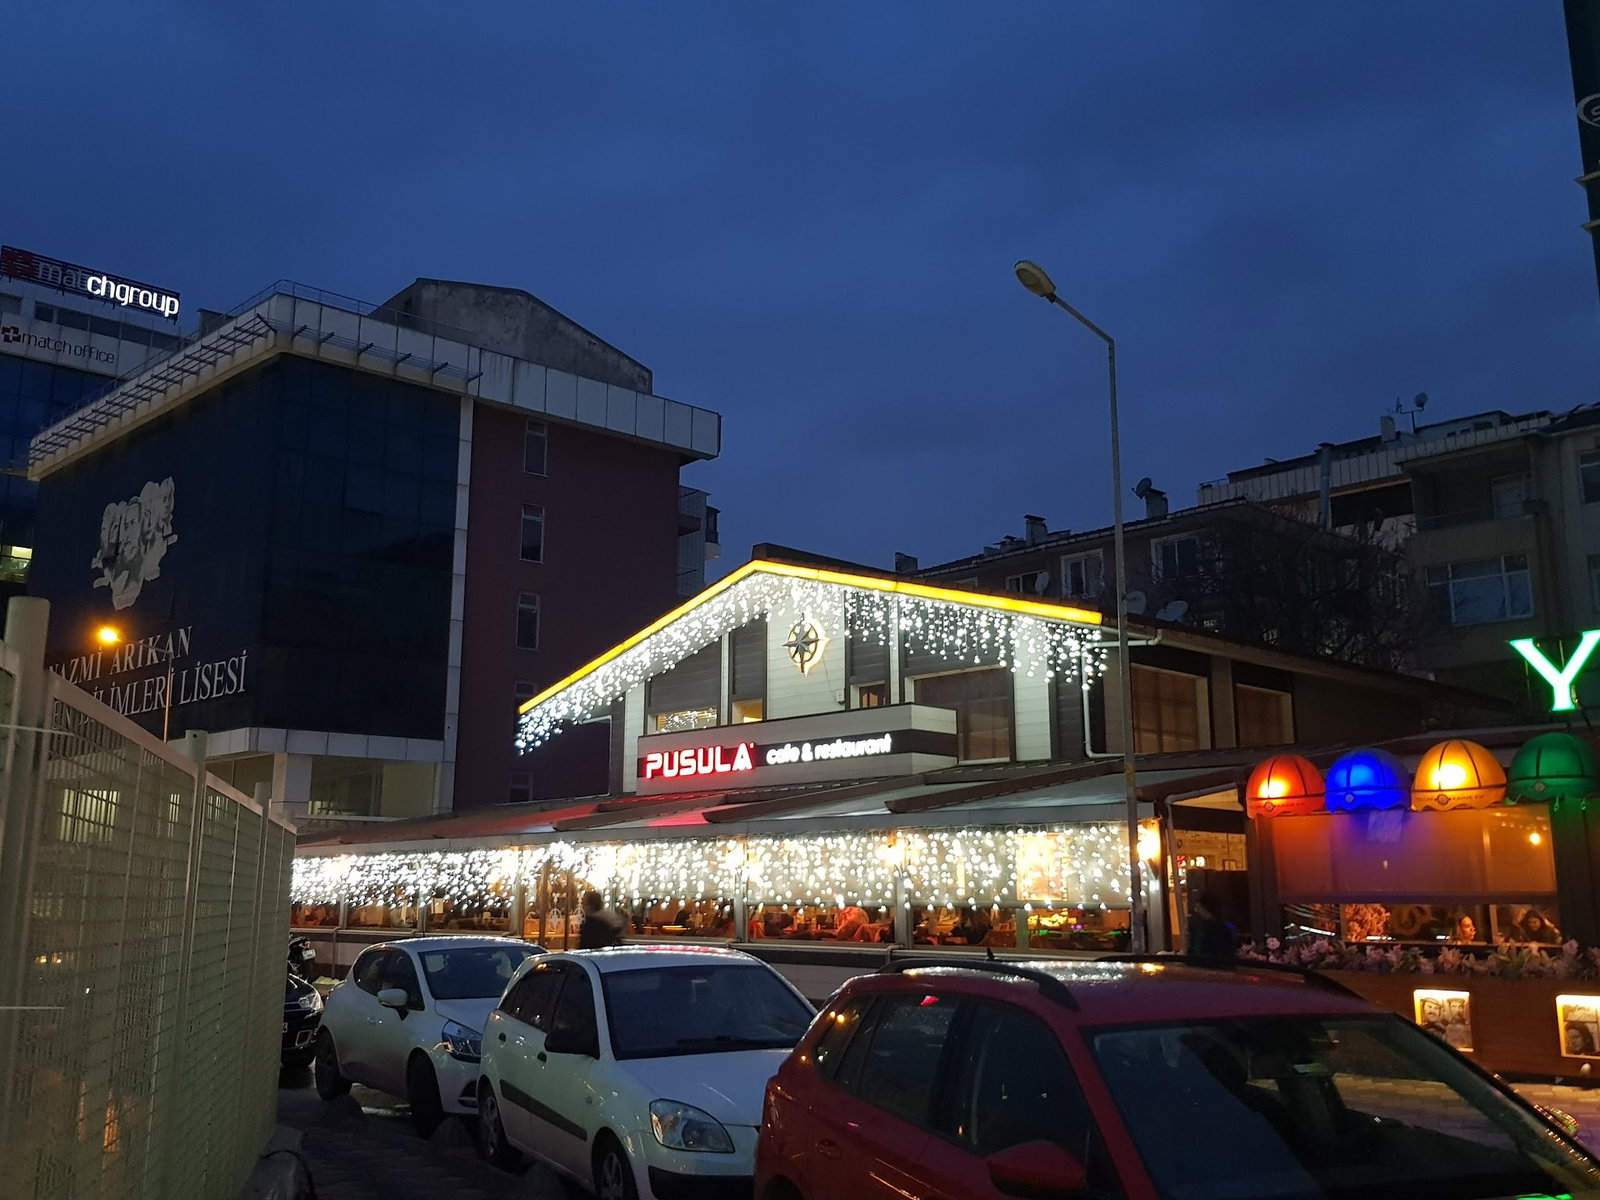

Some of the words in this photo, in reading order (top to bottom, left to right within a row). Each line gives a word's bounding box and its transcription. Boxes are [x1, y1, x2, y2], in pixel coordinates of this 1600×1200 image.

[22, 333, 73, 355] match
[74, 343, 115, 364] office
[178, 649, 249, 706] LİSESİ
[645, 743, 754, 779] PUSULA
[766, 743, 801, 765] cafe
[801, 742, 815, 762] &
[814, 733, 892, 760] restaurant
